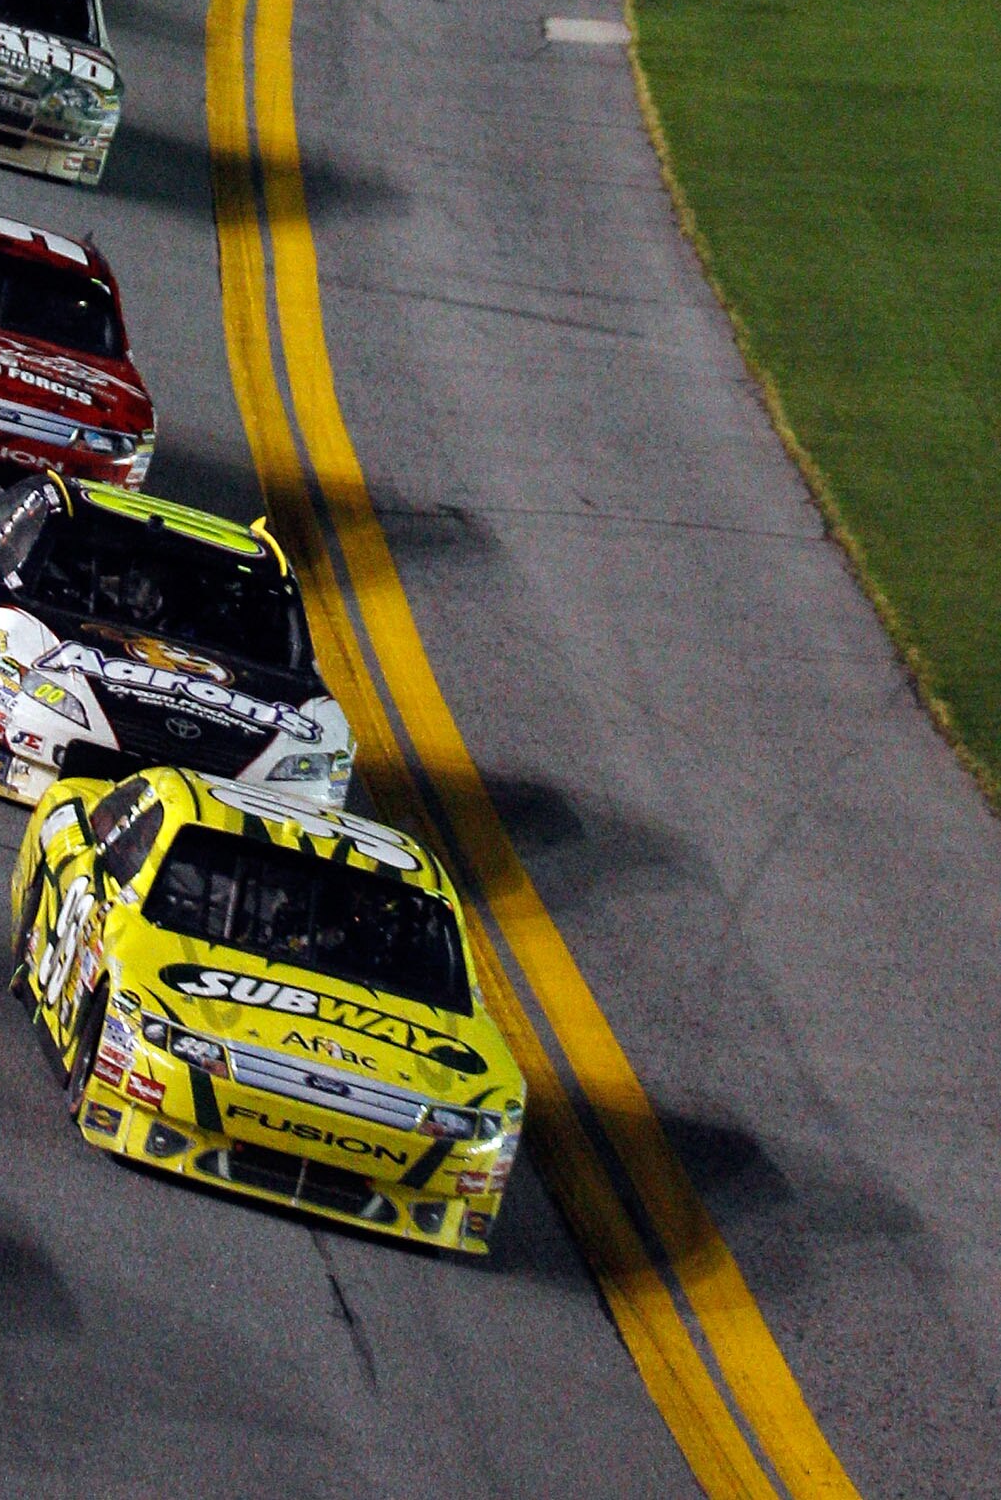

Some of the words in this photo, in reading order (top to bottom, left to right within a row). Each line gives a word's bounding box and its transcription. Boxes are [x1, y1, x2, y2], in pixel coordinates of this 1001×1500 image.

[8, 368, 93, 406] FORCES
[31, 640, 324, 744] Aaron's
[34, 682, 66, 704] 00
[177, 970, 470, 1060] SUBWAY
[282, 1030, 378, 1071] Aflac
[226, 1103, 408, 1166] FUSION
